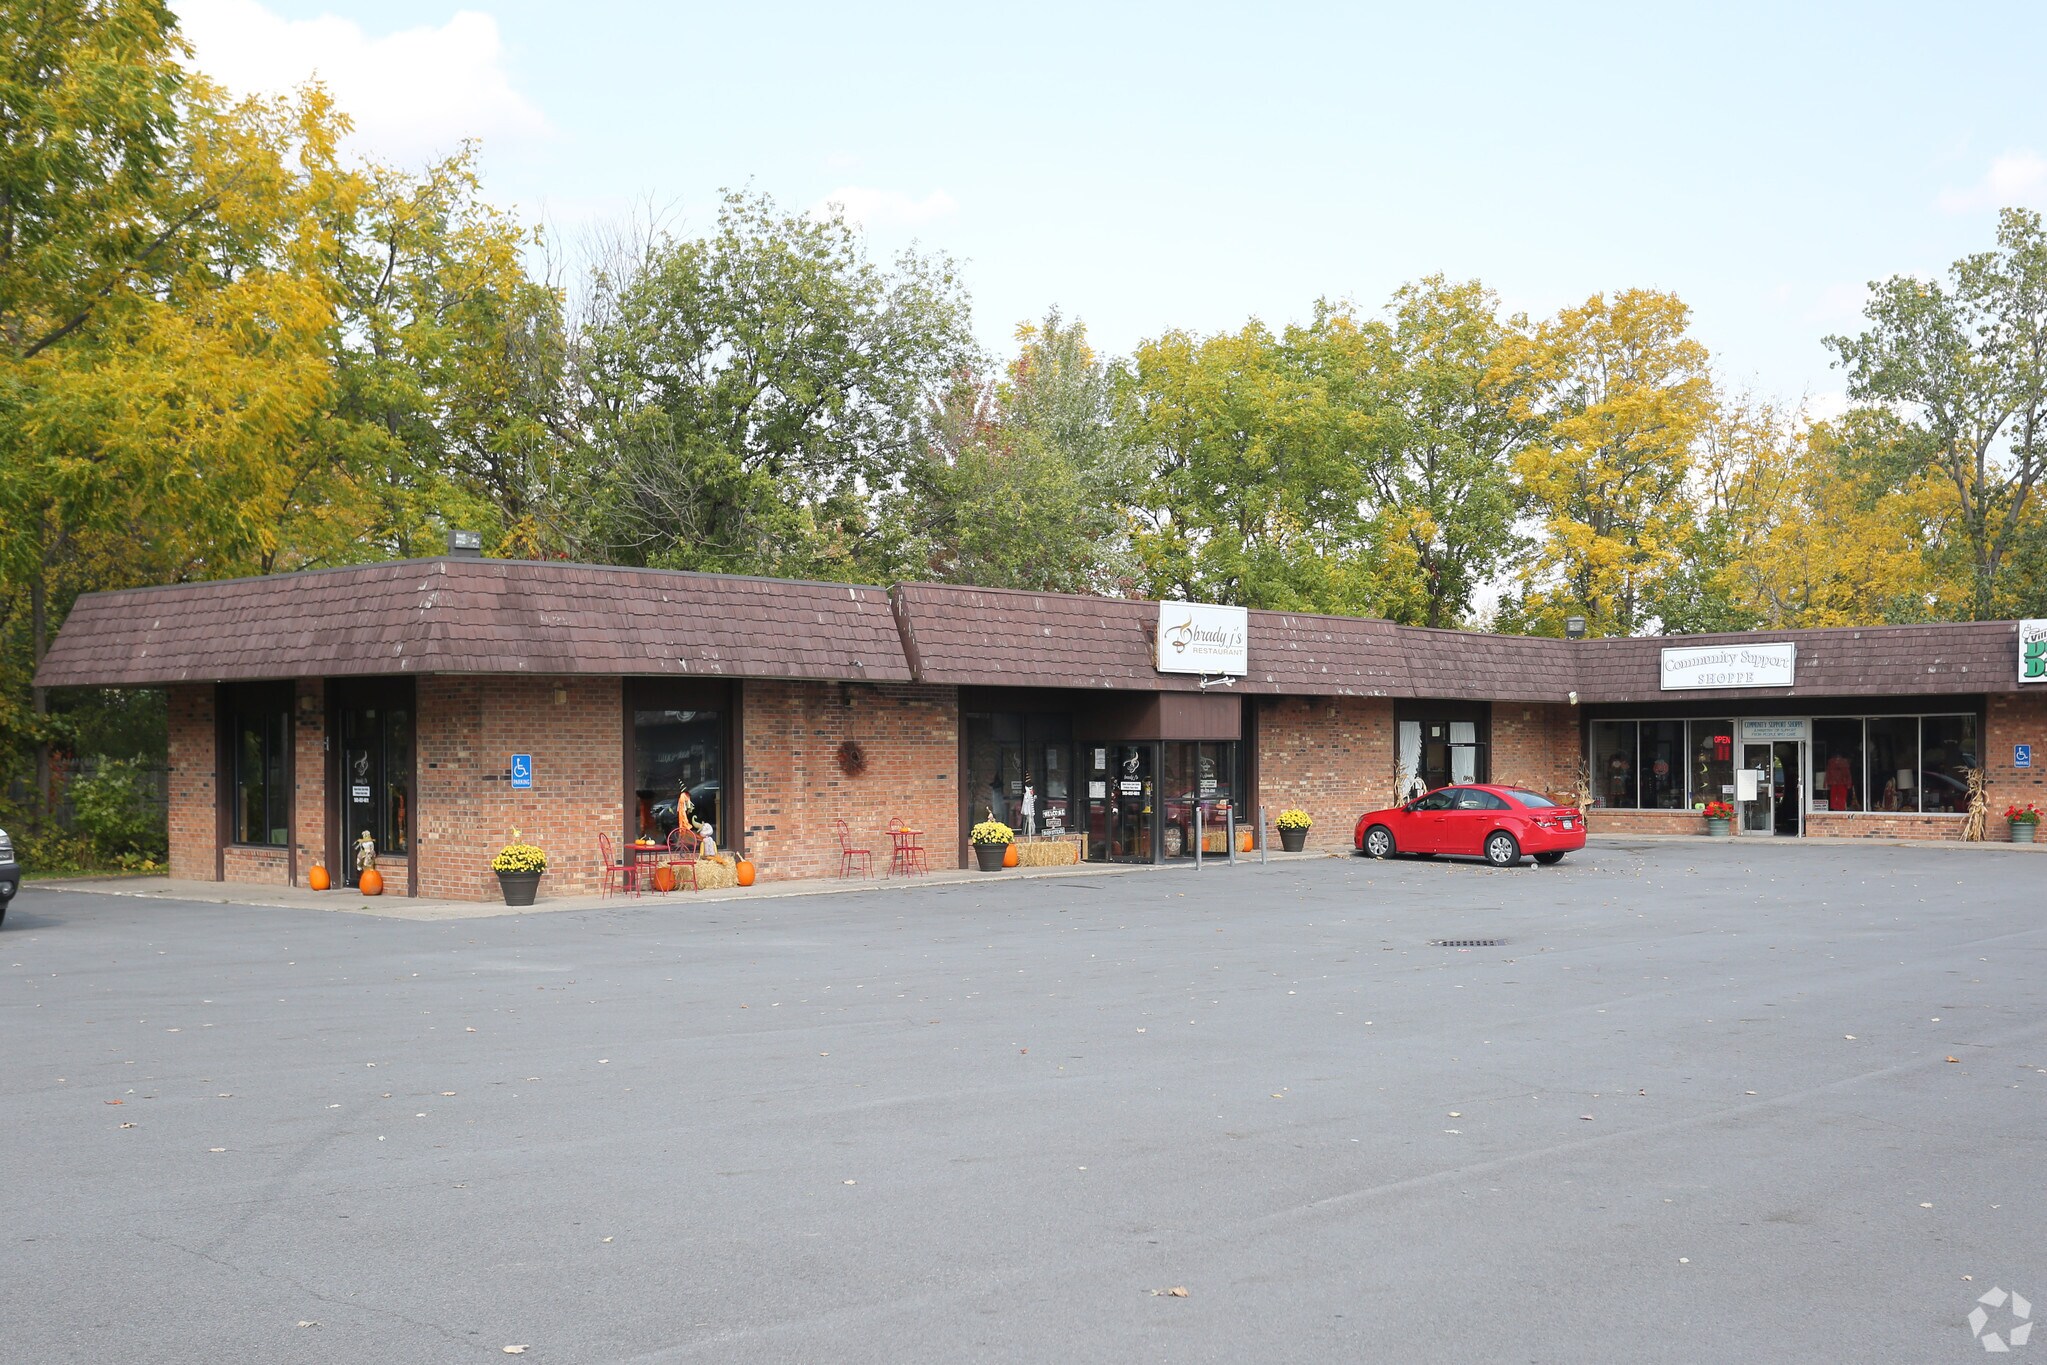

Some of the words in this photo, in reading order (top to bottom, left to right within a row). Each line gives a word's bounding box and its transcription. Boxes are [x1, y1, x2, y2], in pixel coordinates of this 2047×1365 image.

[1194, 624, 1227, 648] brady
[1226, 626, 1242, 649] j's
[1192, 647, 1243, 656] RESTAURANT
[1665, 650, 1738, 672] Community
[1740, 650, 1790, 669] Support
[1697, 672, 1754, 685] SHOPPE
[1768, 720, 1786, 728] SUPPORT
[1787, 720, 1804, 728] SHOPPE
[1713, 735, 1731, 744] OPEN
[1462, 775, 1474, 783] OPEN
